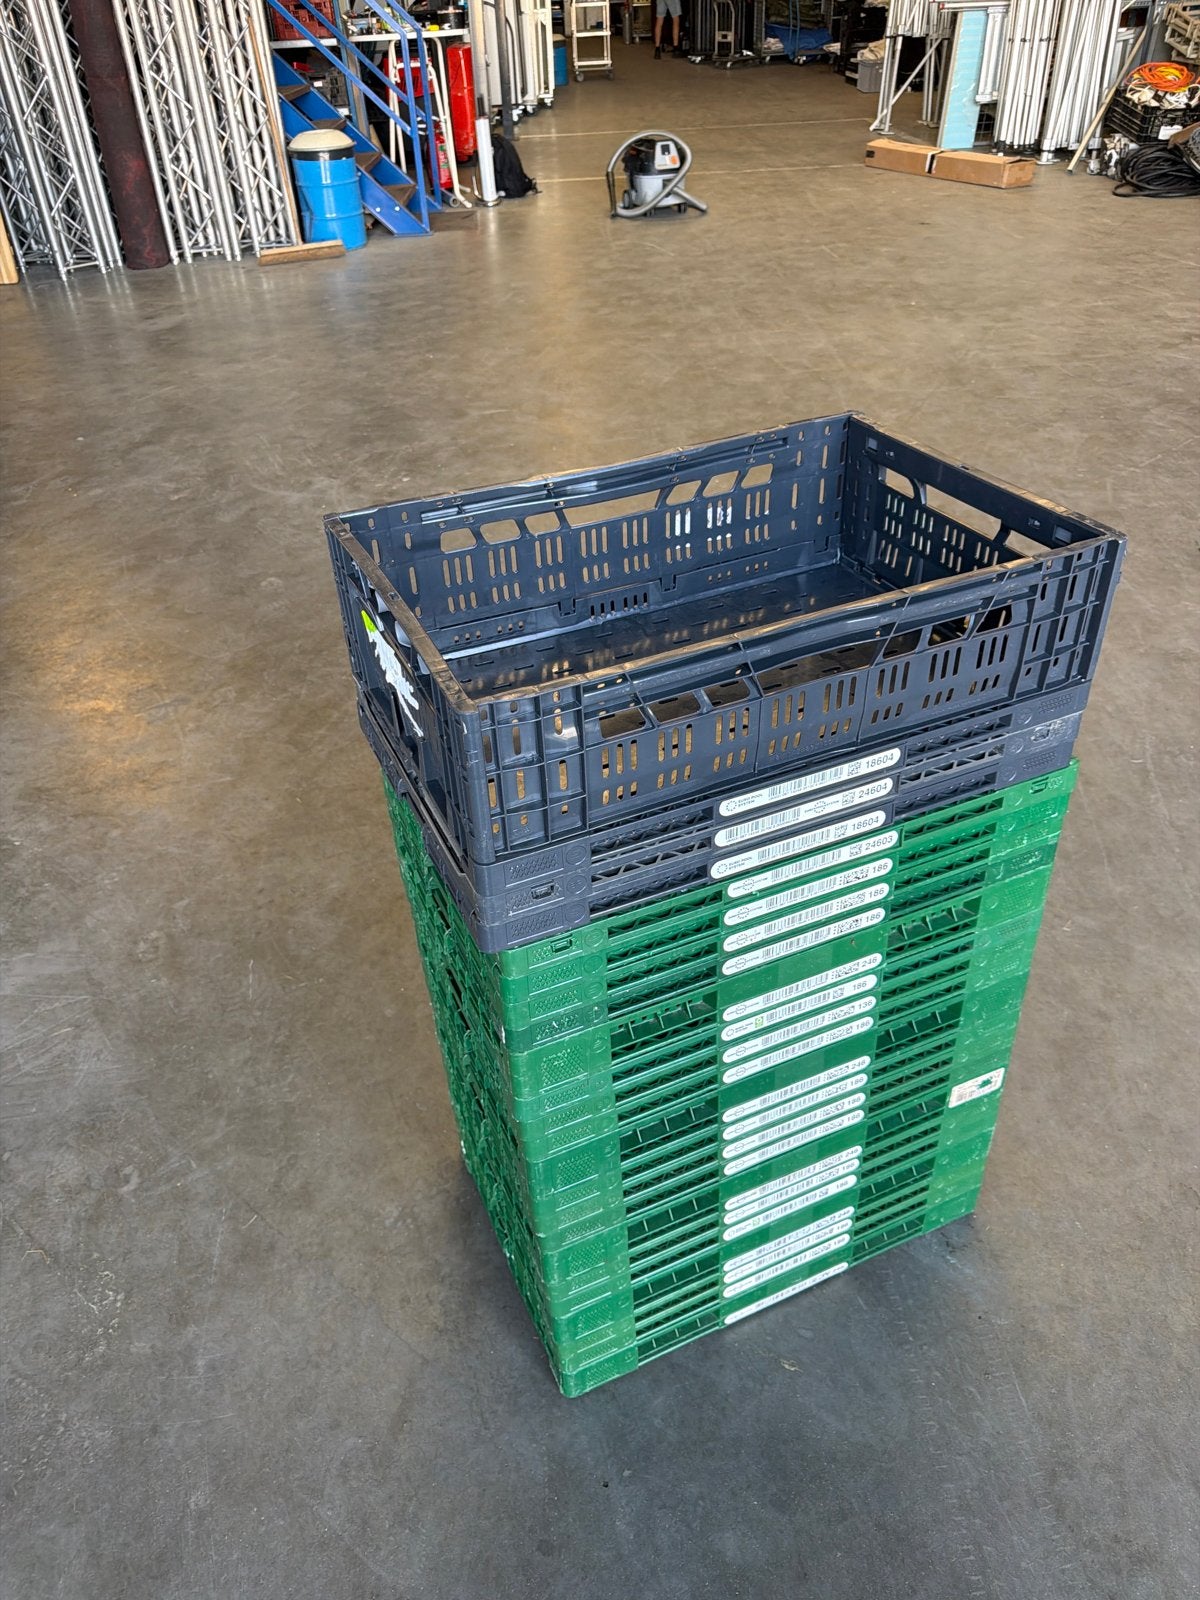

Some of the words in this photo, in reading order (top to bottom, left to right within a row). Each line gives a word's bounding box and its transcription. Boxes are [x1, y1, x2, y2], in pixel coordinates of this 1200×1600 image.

[866, 752, 894, 769] 18604
[858, 782, 888, 799] 24604
[851, 815, 879, 831] 18604
[865, 834, 893, 851] 24603
[872, 862, 888, 874] 186
[869, 887, 885, 898] 186
[865, 911, 881, 923] 186
[853, 980, 867, 991] 186
